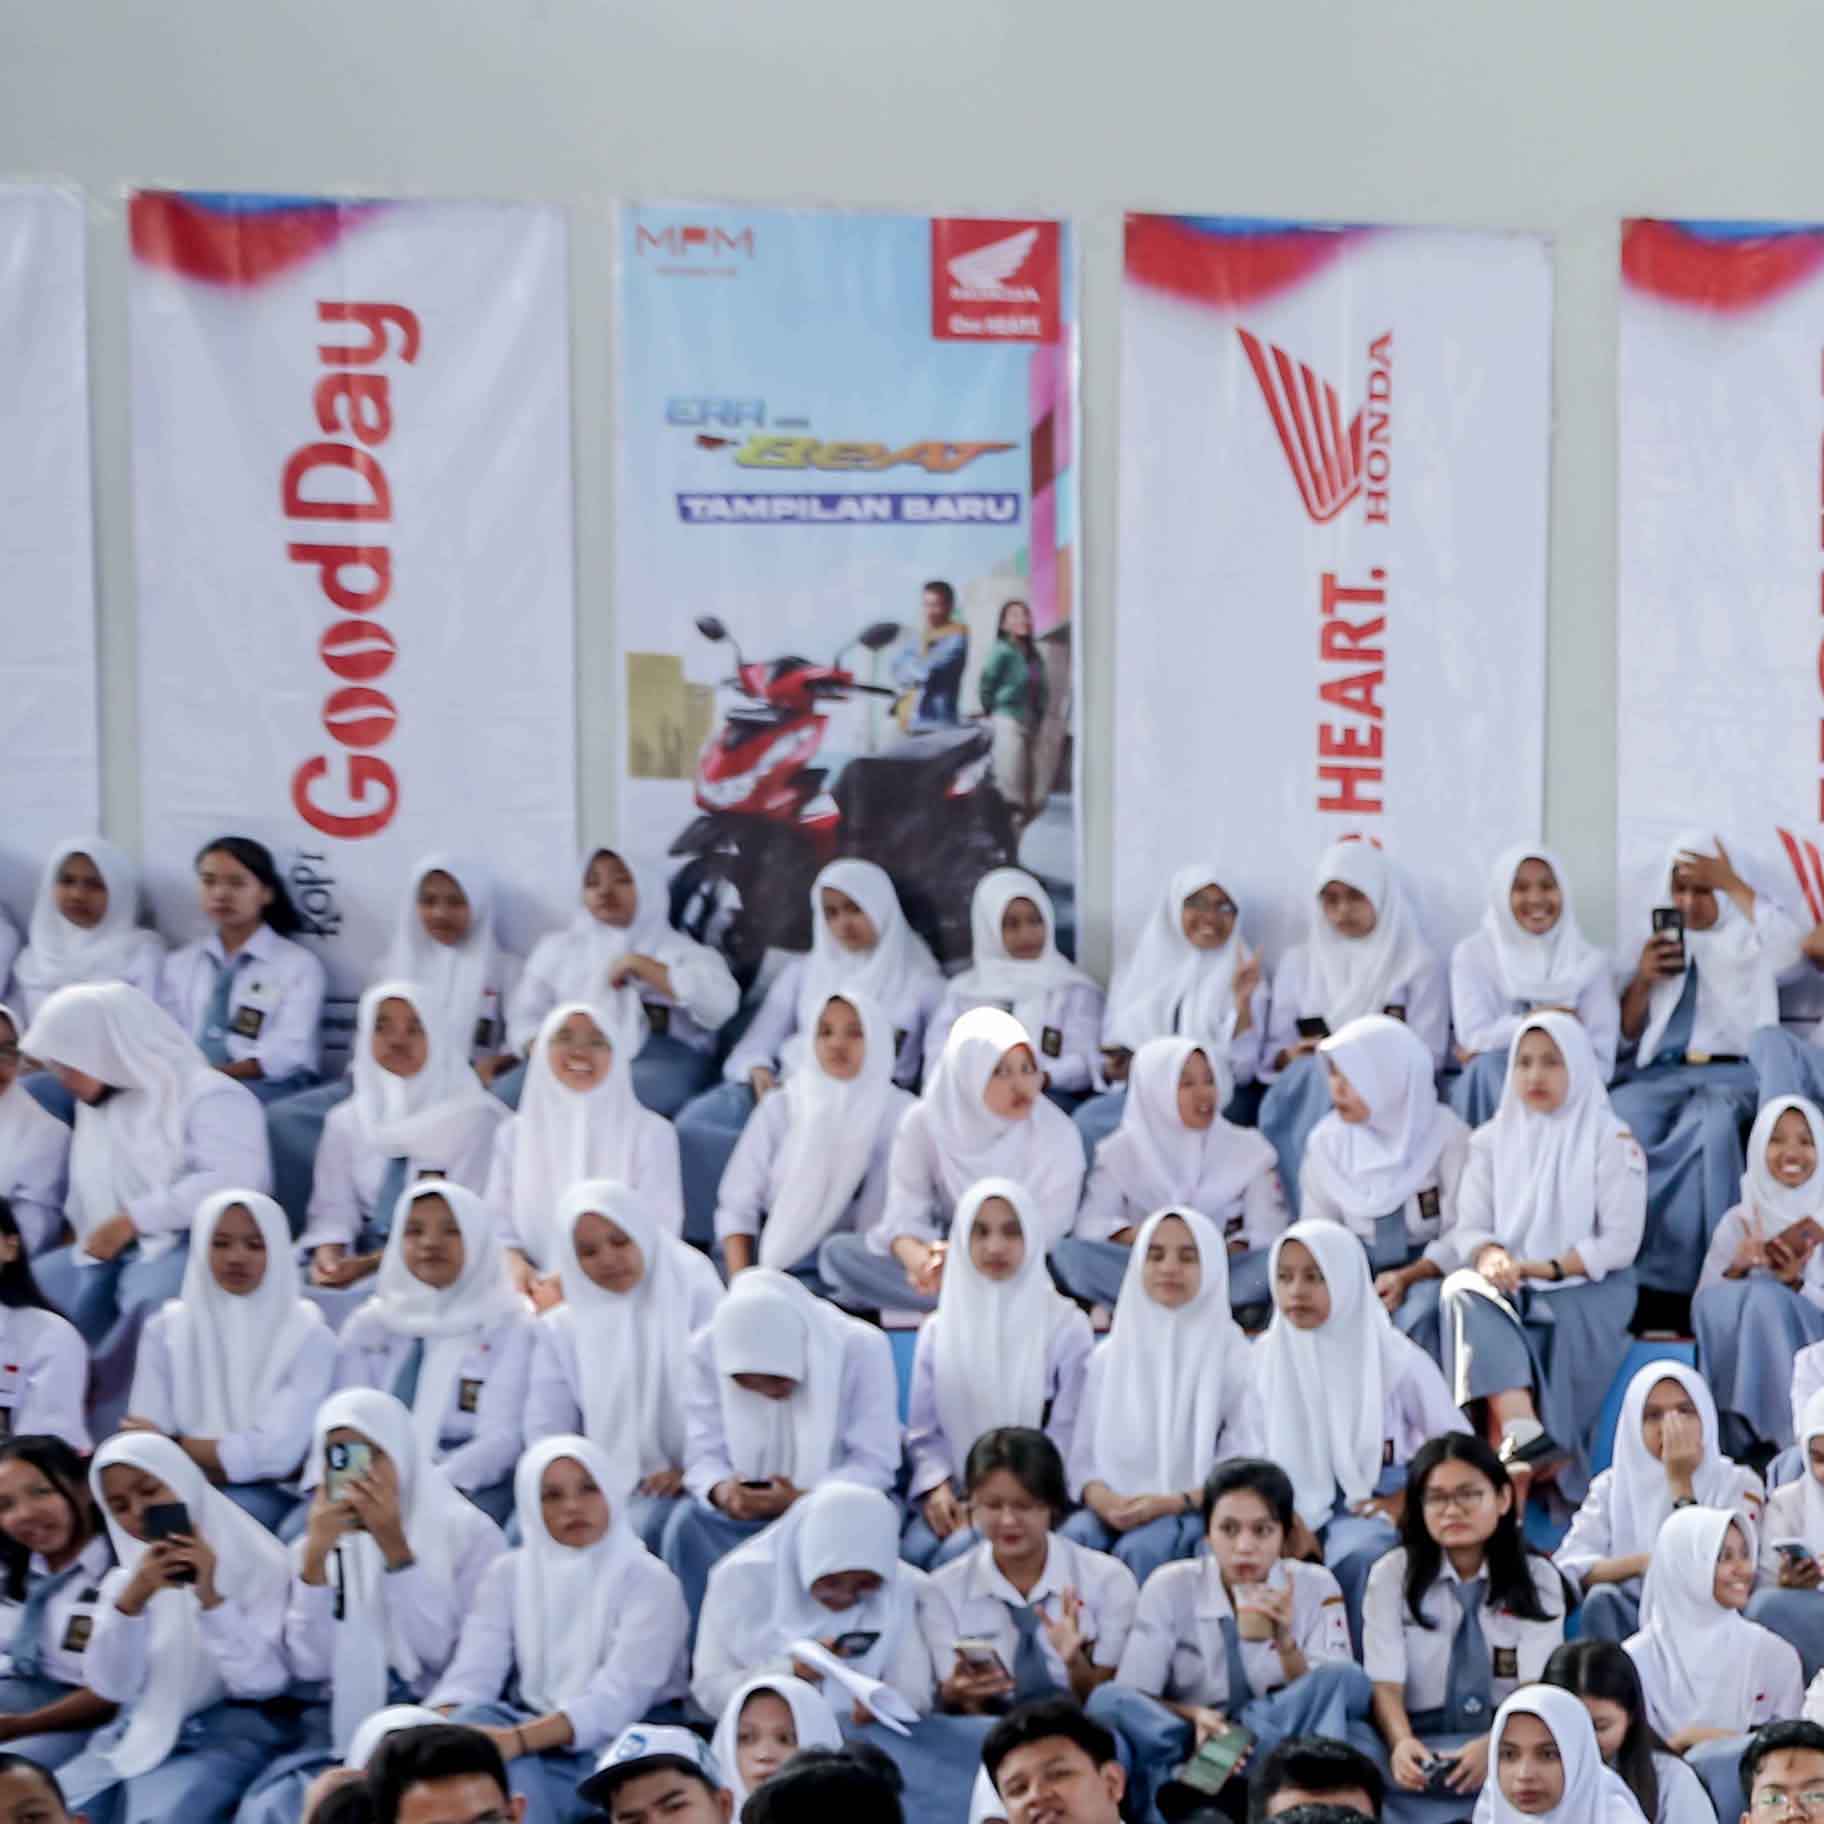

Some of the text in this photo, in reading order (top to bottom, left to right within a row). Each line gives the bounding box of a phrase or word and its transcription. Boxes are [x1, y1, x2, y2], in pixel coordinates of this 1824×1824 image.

[636, 224, 754, 259] MPM
[1364, 330, 1393, 525] HONDA
[682, 495, 1016, 522] TAMPILAN BARU
[1317, 566, 1388, 815] HEART.
